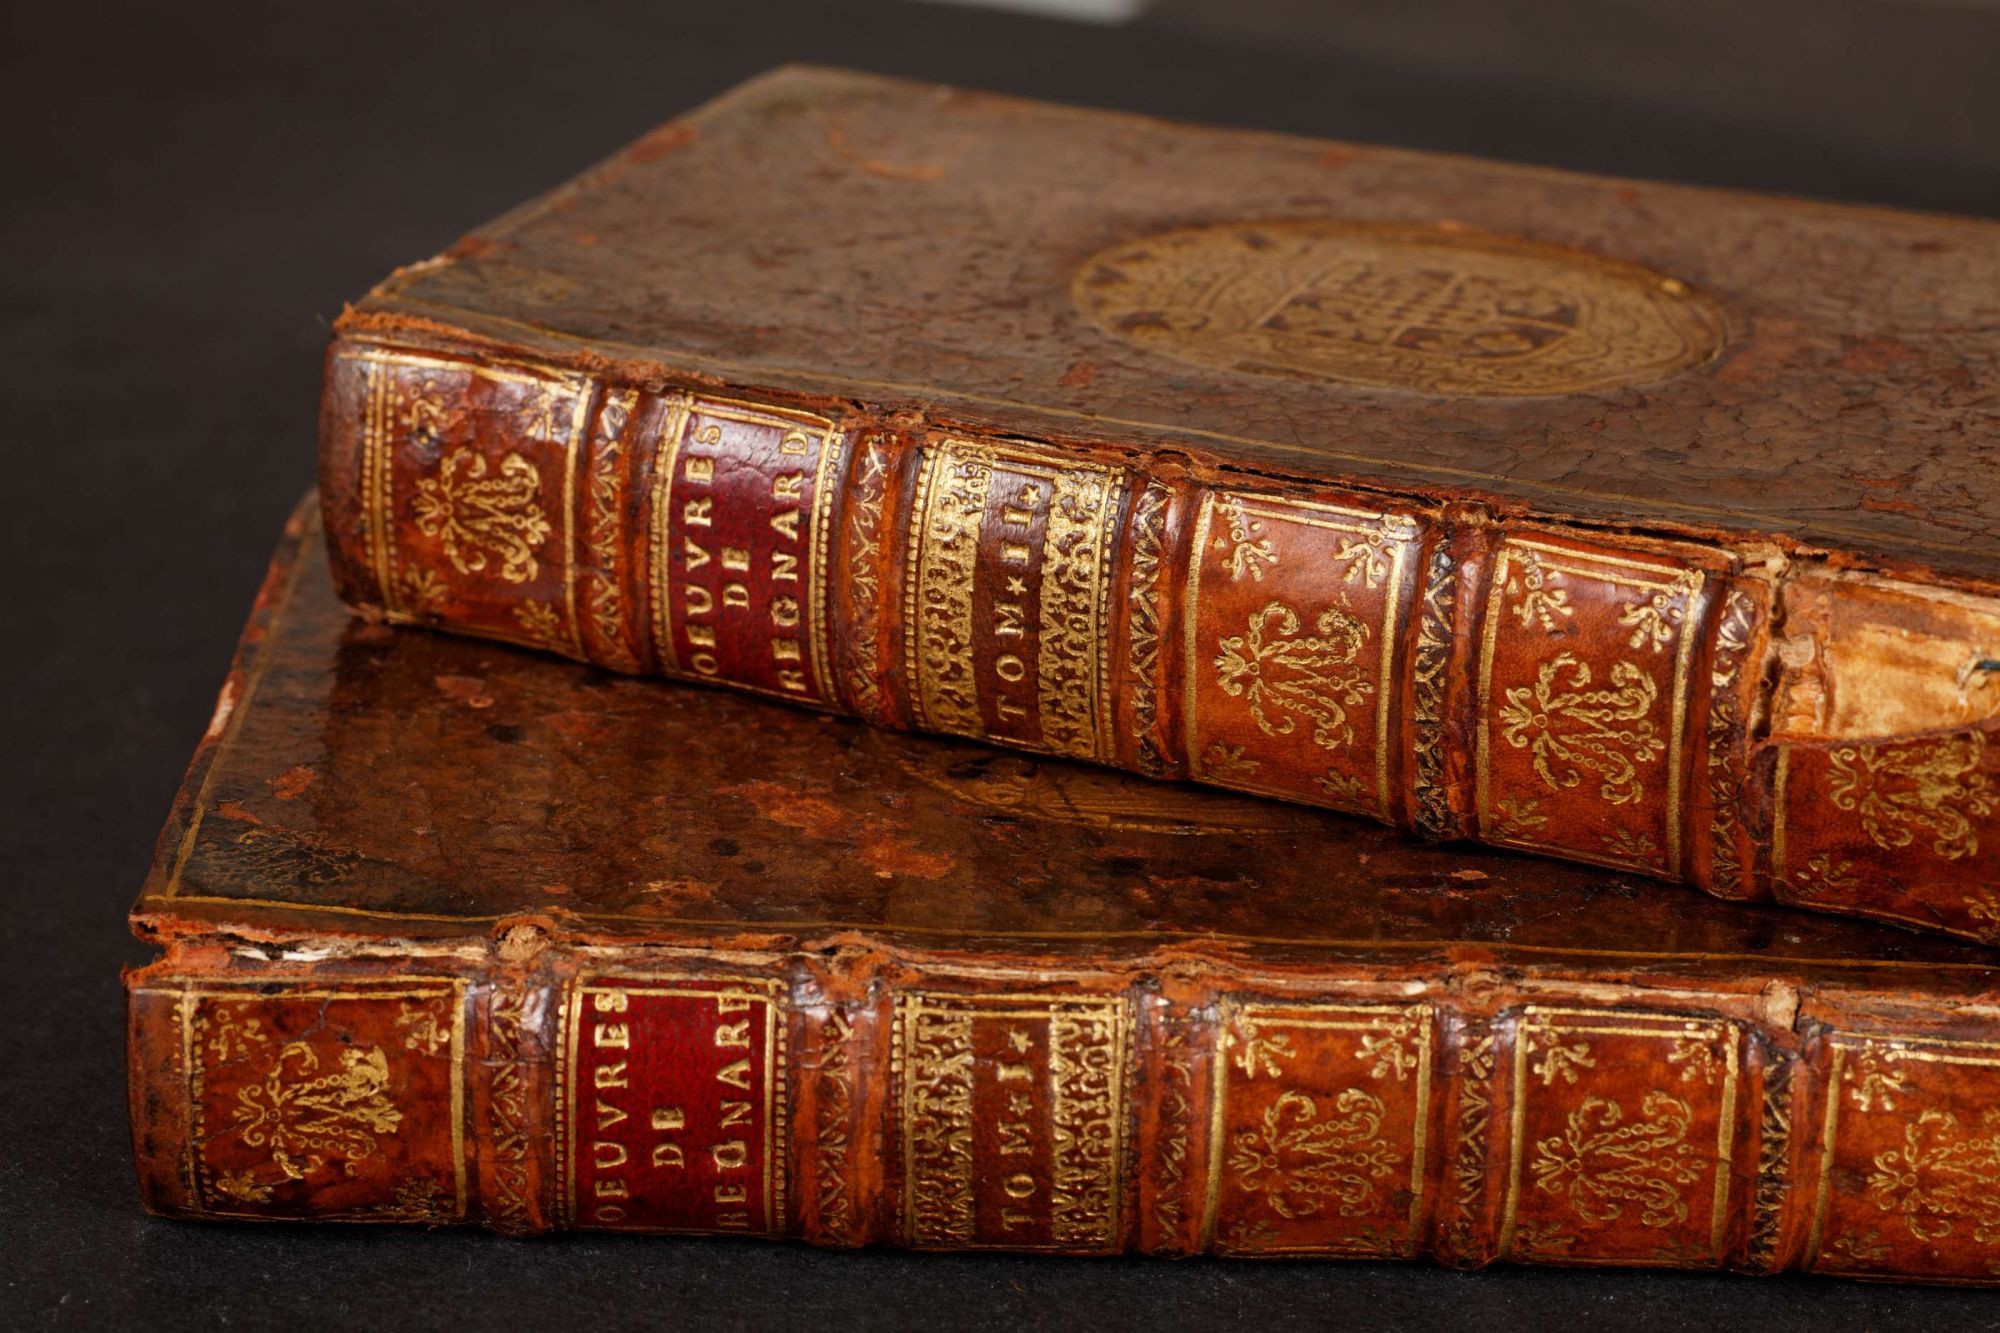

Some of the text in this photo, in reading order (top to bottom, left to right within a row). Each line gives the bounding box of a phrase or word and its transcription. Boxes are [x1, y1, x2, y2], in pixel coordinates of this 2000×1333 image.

[684, 425, 722, 675] OEUVRES
[722, 547, 750, 610] DE
[770, 431, 808, 691] REGNARD
[594, 988, 630, 1222] OEUVRES
[652, 1107, 685, 1169] DE
[714, 985, 752, 1228] REGNARD
